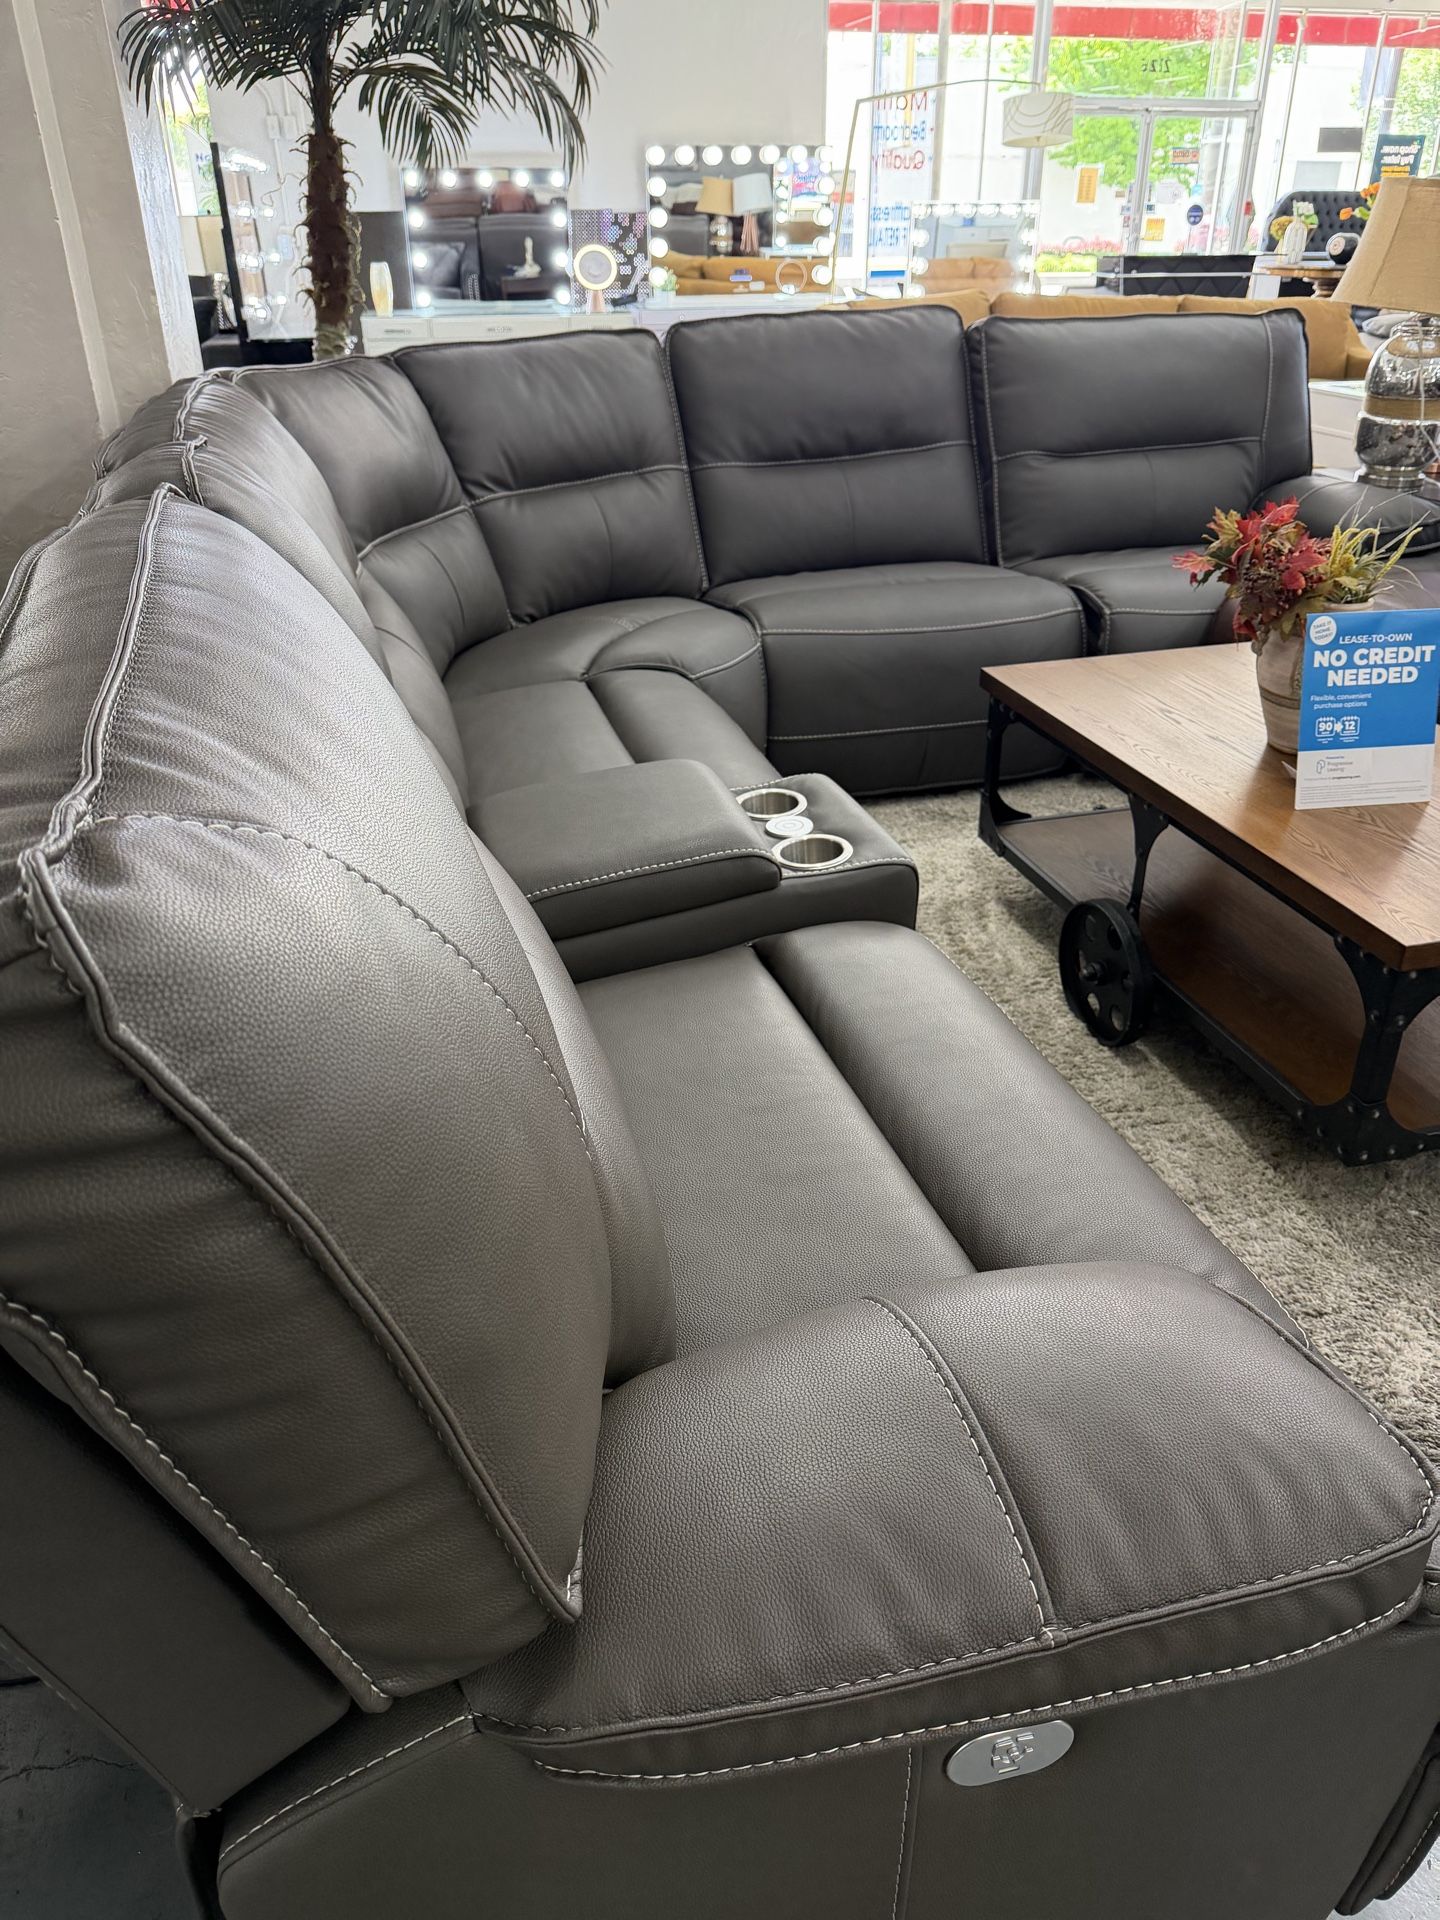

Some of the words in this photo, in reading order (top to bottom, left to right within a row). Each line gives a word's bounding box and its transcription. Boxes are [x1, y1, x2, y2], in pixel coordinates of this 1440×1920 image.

[1339, 633, 1413, 644] LEASE-TO-OWN
[1313, 649, 1348, 668] NO
[1353, 645, 1436, 665] CREDIT
[1319, 722, 1333, 732] 90
[1344, 721, 1356, 730] 12
